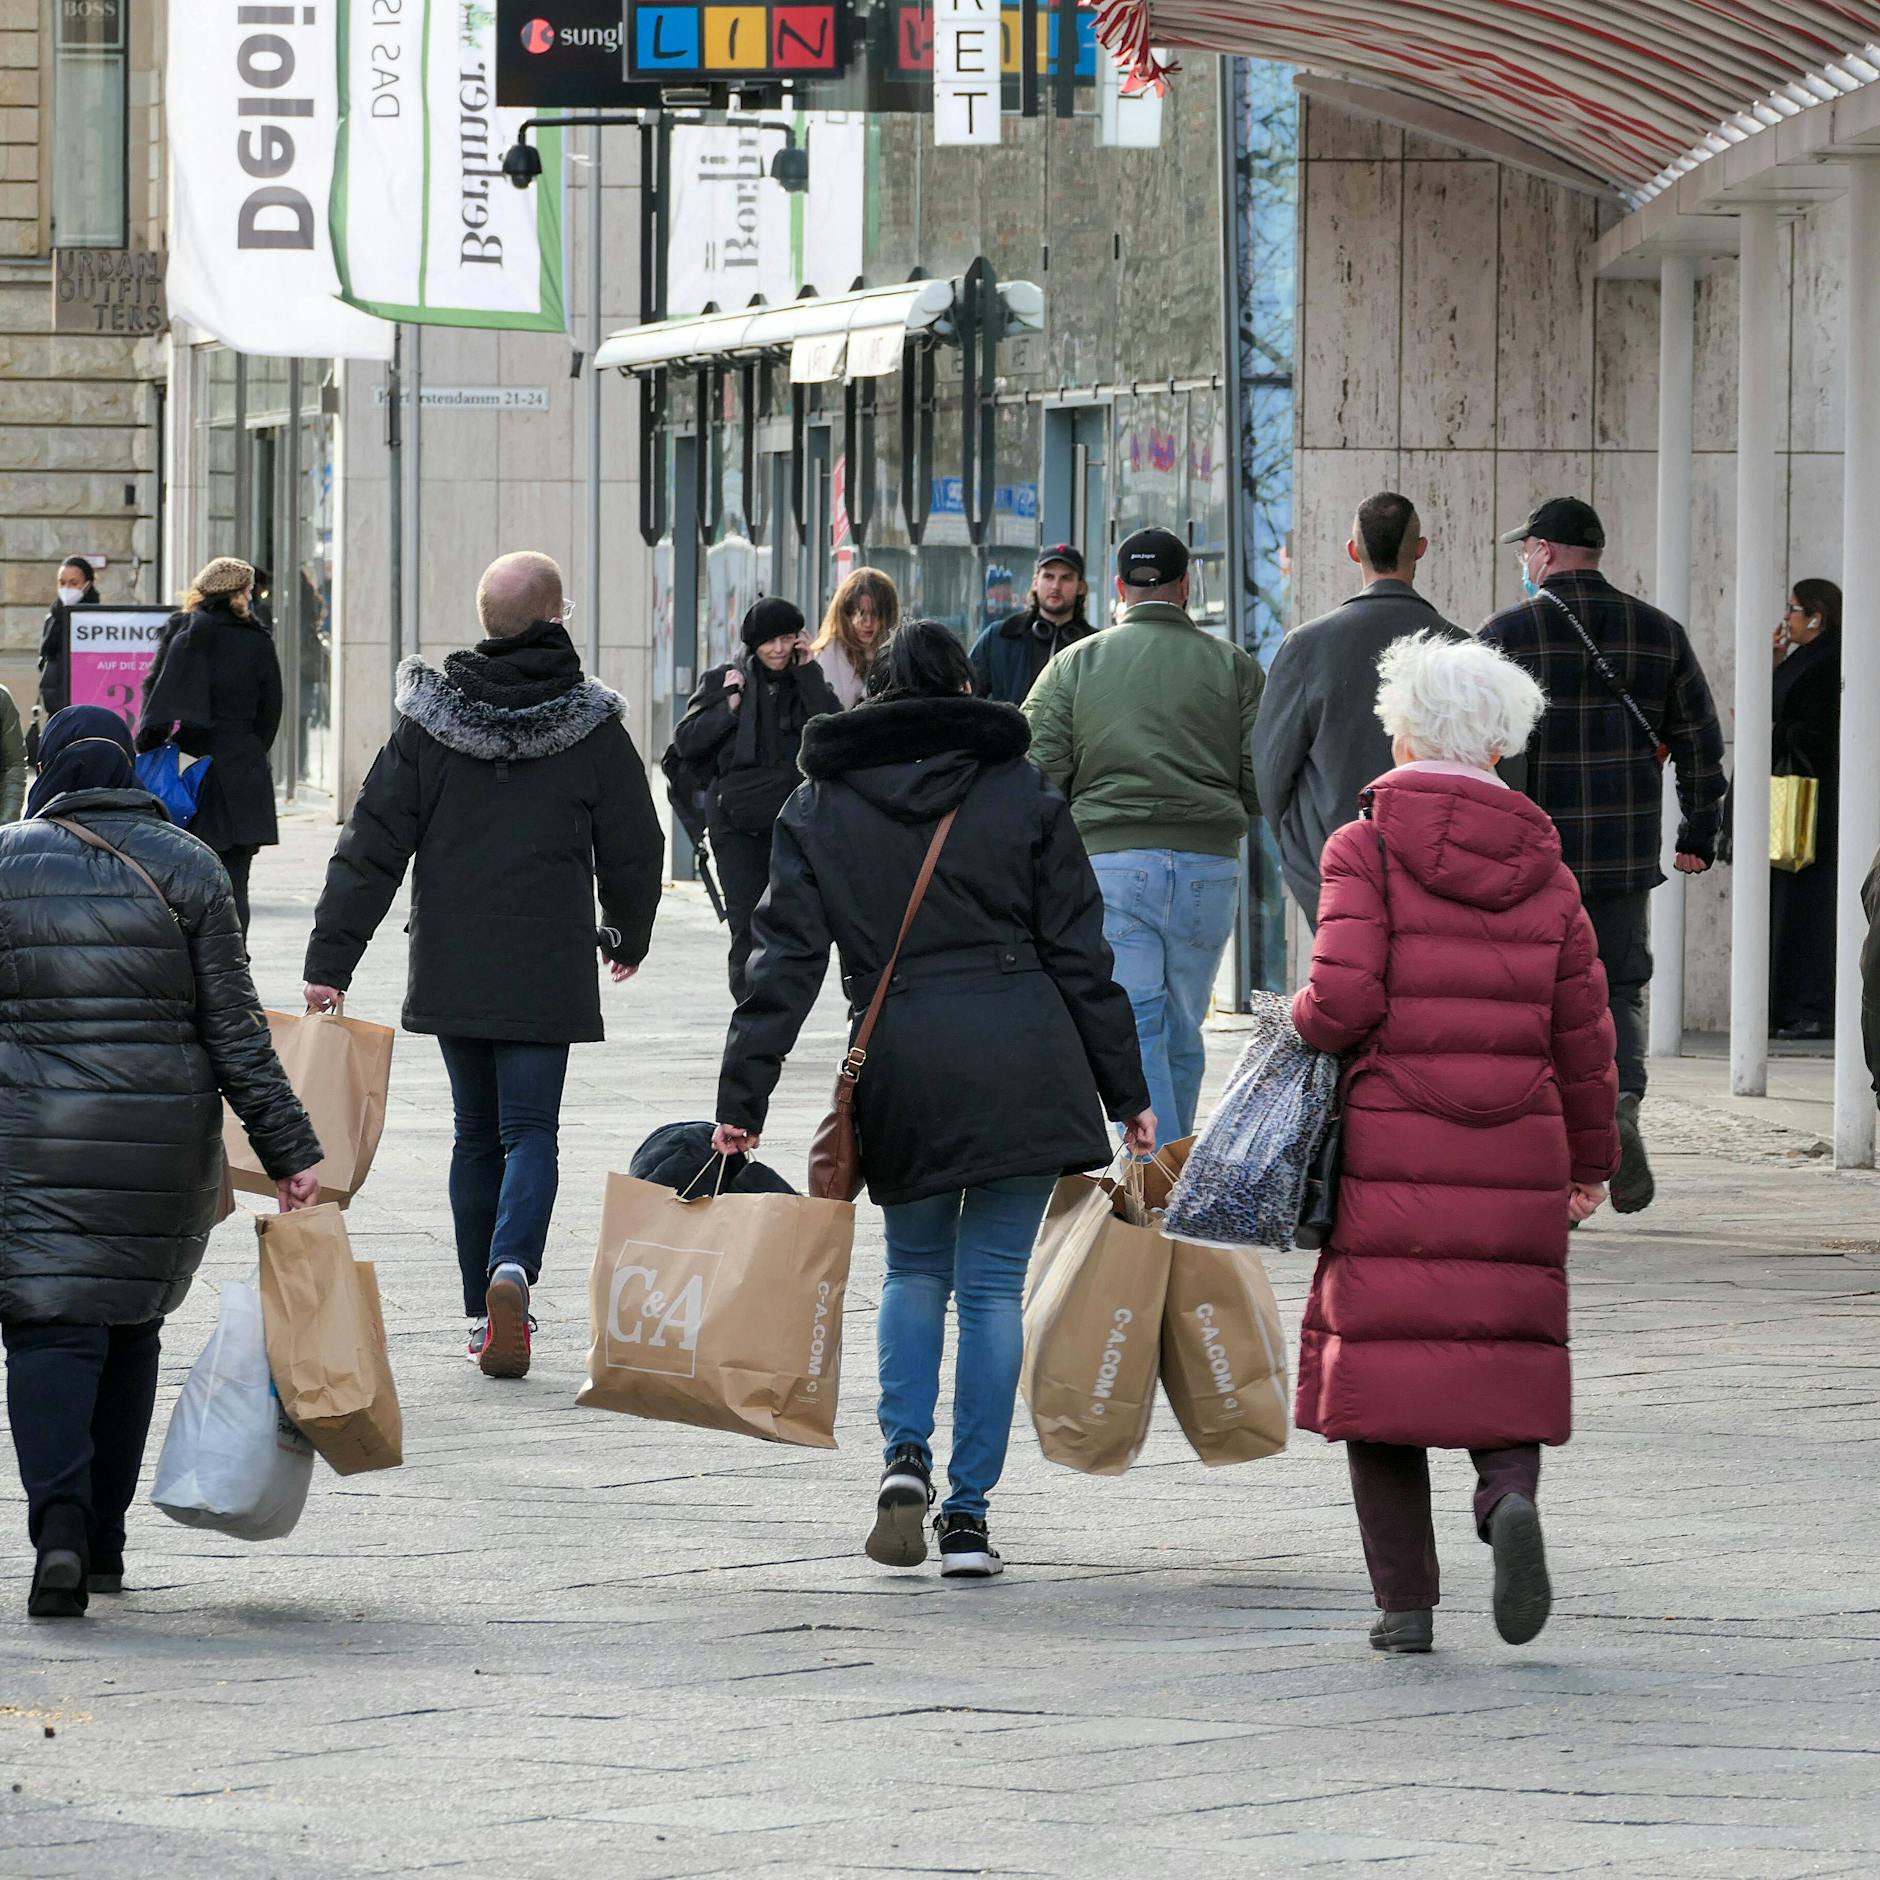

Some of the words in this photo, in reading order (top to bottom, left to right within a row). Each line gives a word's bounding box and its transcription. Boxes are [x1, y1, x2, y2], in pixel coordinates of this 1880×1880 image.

[63, 0, 117, 17] BOSS
[952, 0, 989, 135] ET
[58, 251, 158, 279] URBAN
[60, 277, 162, 304] OUTFIT
[93, 304, 163, 331] TERS
[504, 391, 544, 406] 21-24
[97, 661, 117, 671] AUF
[120, 661, 136, 671] DIE
[607, 1265, 704, 1351] C&A
[808, 1280, 831, 1376] C-A.COM
[1092, 1308, 1134, 1399] C-A.COM
[1196, 1302, 1236, 1394] C-A.COM
